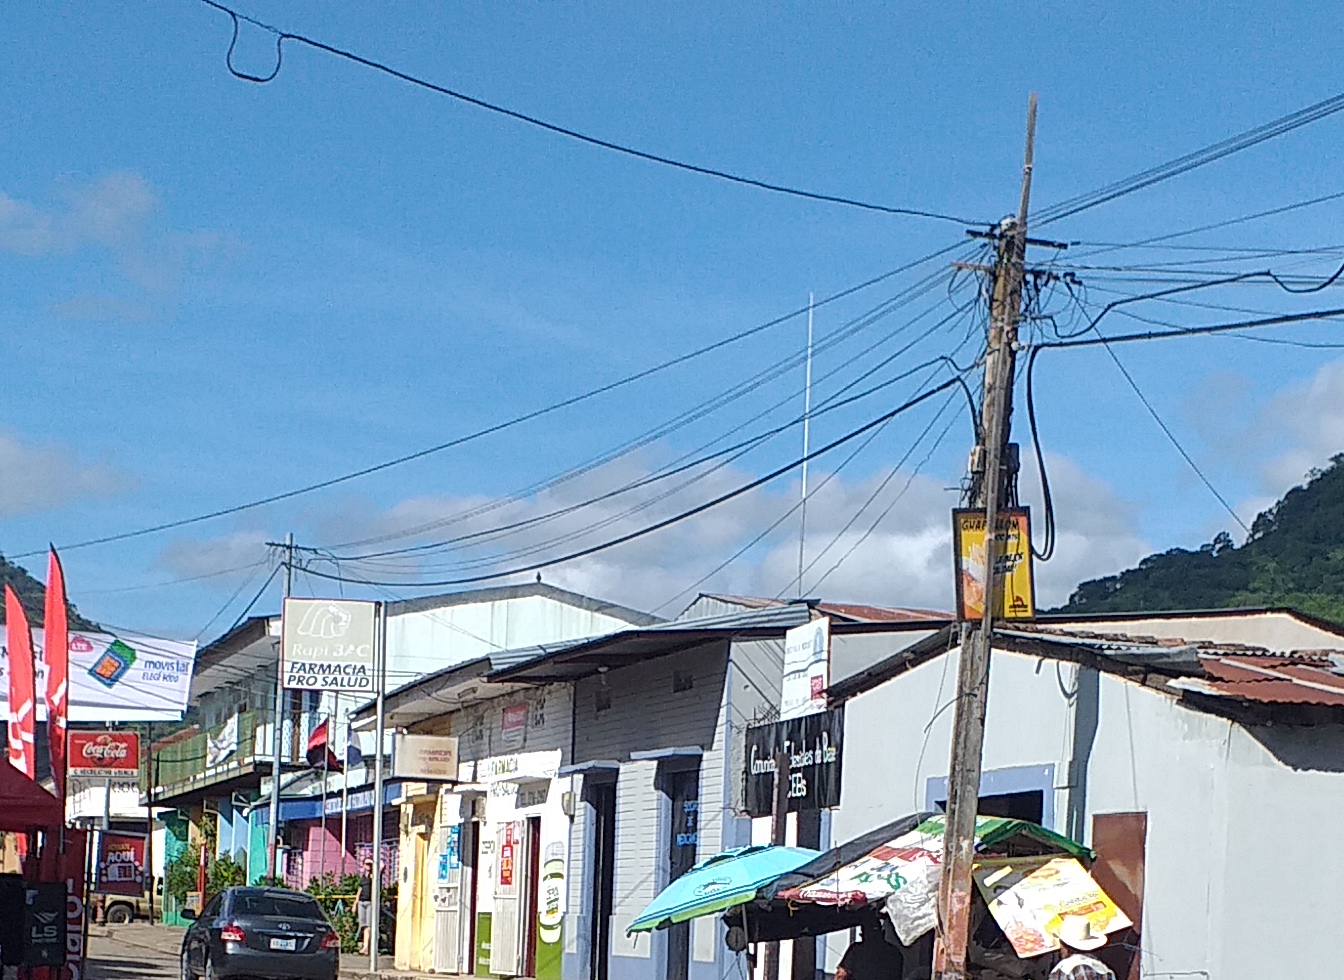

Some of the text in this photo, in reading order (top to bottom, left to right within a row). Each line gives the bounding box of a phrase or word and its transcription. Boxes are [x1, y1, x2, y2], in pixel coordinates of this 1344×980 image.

[292, 643, 329, 659] Rapi
[144, 659, 190, 673] movistar
[289, 661, 367, 676] FARMACIA
[287, 674, 370, 688] PRO SALUD
[82, 741, 129, 759] Coca-Cola
[31, 925, 58, 938] LS
